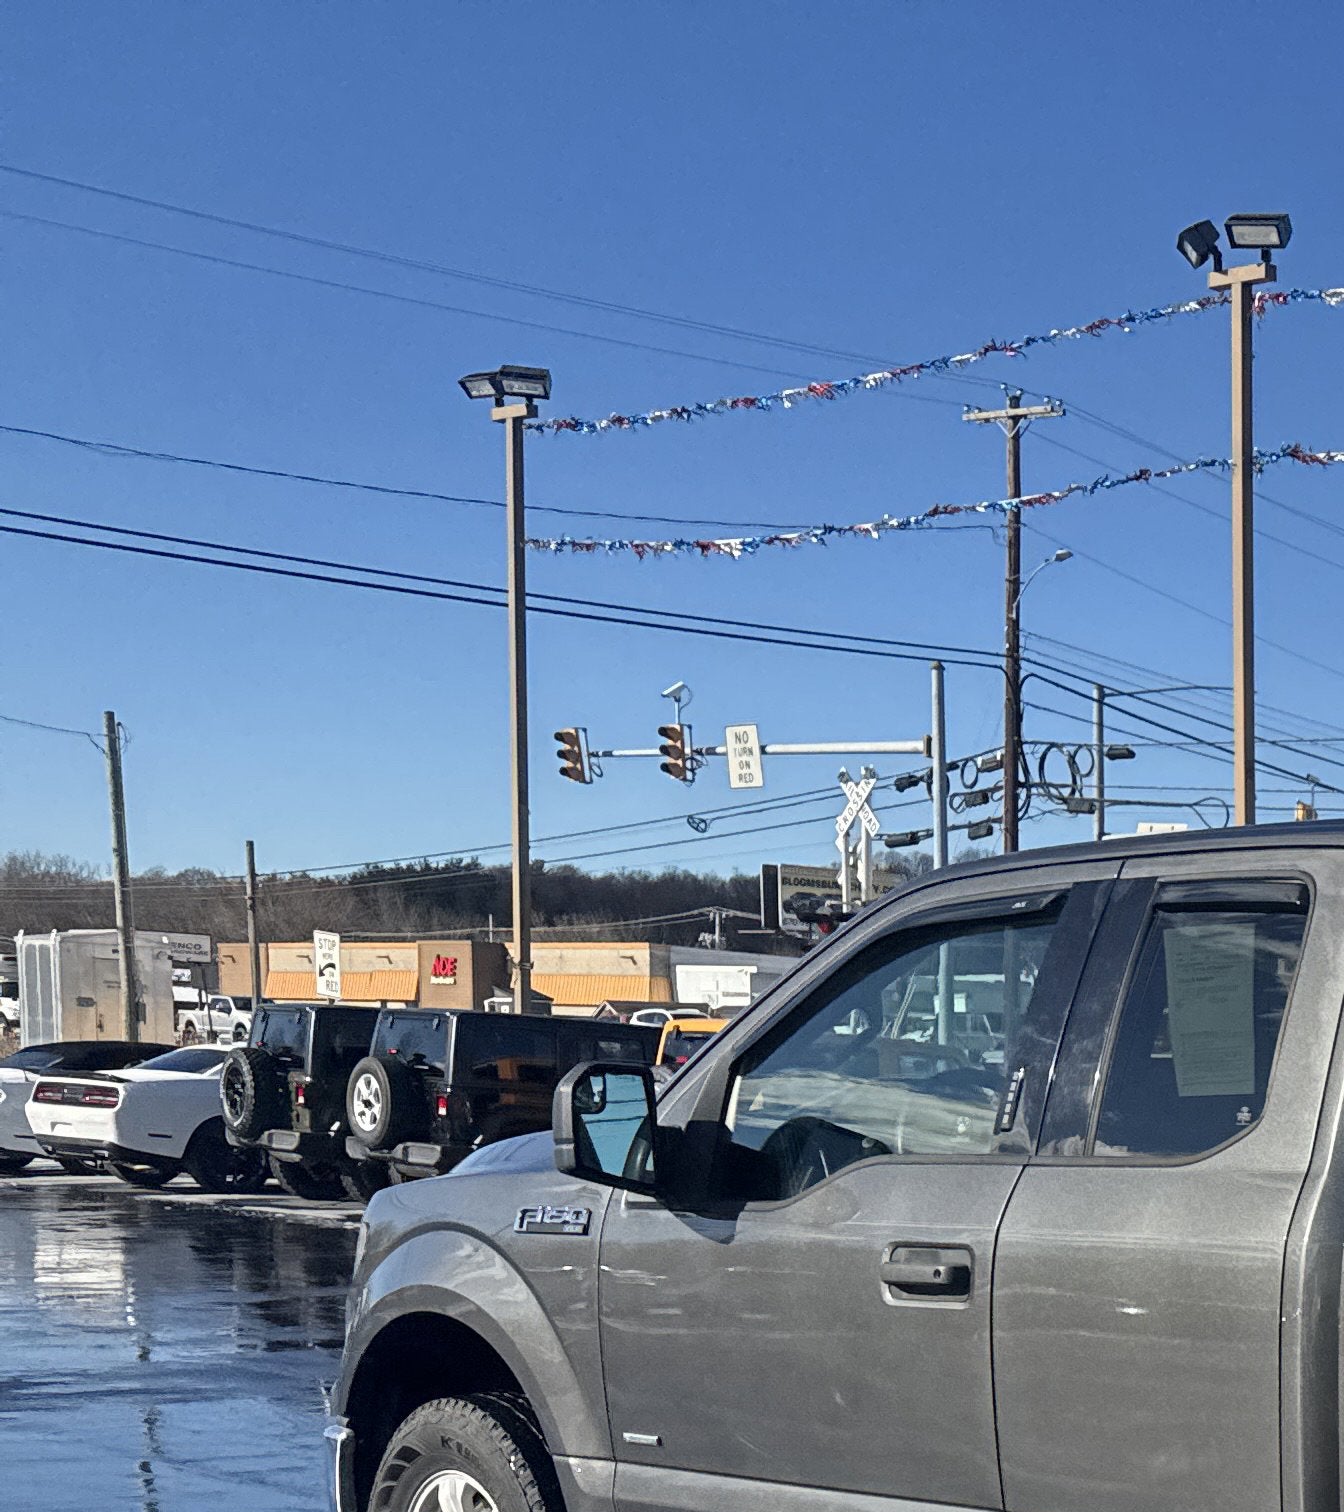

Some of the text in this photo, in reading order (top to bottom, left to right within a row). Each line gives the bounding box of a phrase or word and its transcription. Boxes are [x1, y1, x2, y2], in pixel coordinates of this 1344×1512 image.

[734, 730, 749, 745] NO
[733, 746, 754, 758] TURN
[738, 759, 751, 771] ON
[737, 772, 754, 784] RED
[838, 780, 872, 832] CROSSIN
[318, 937, 337, 951] STOP
[431, 954, 458, 977] ACE
[325, 979, 339, 993] RED
